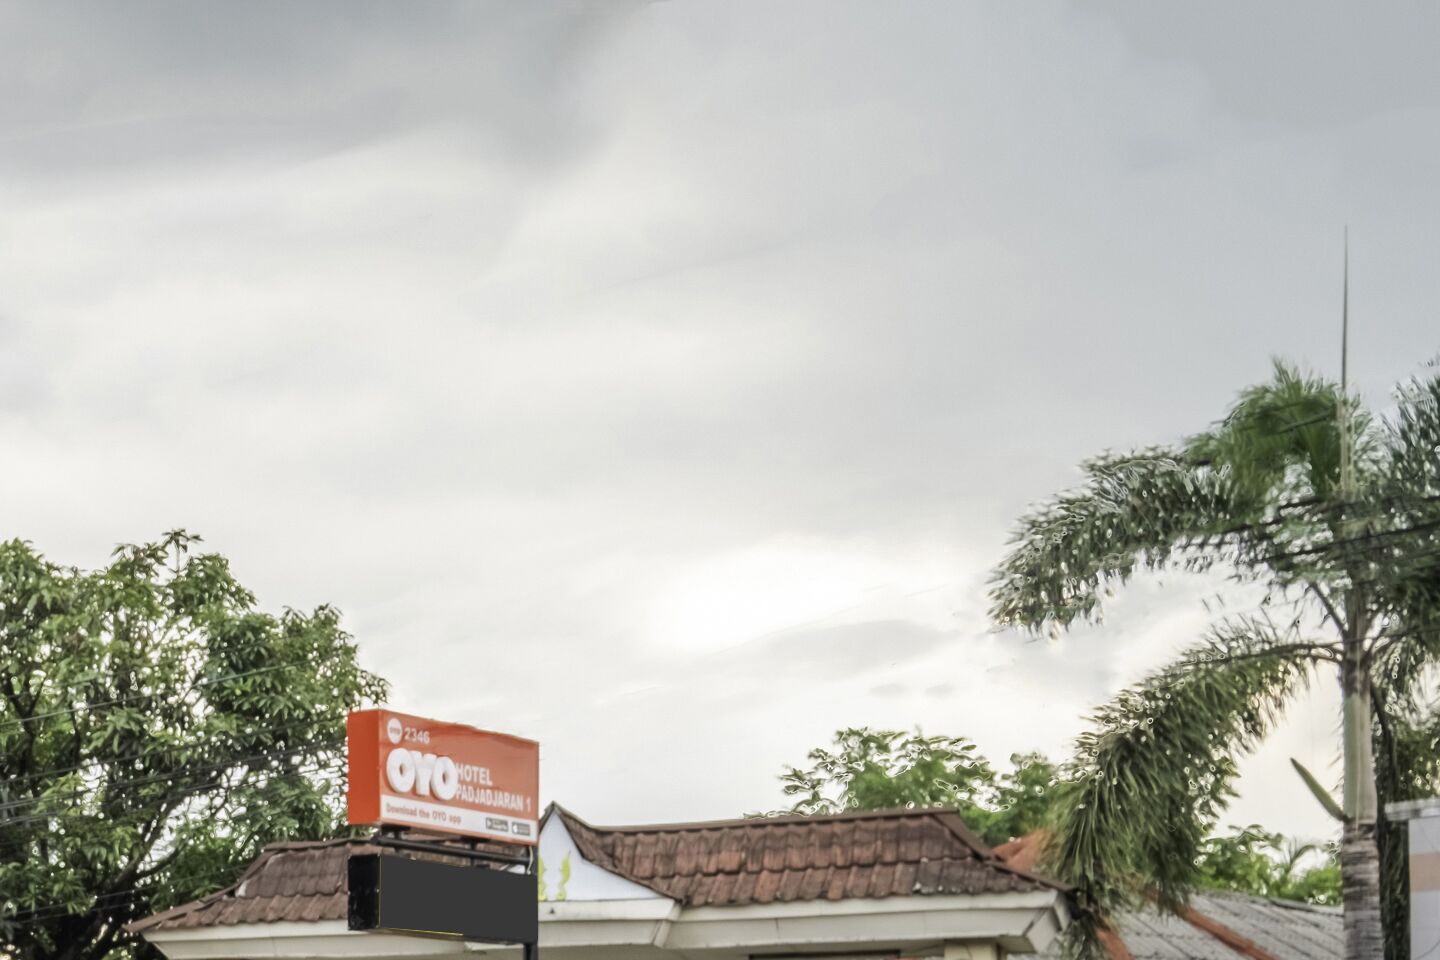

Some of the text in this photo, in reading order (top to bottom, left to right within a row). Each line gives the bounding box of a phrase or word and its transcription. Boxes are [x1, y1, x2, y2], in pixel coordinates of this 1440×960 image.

[404, 727, 430, 744] 2346
[386, 748, 458, 800] OYO
[456, 762, 493, 786] HOTEL
[456, 784, 524, 812] PADJADJARAN
[419, 808, 430, 819] the
[432, 811, 447, 822] OYO
